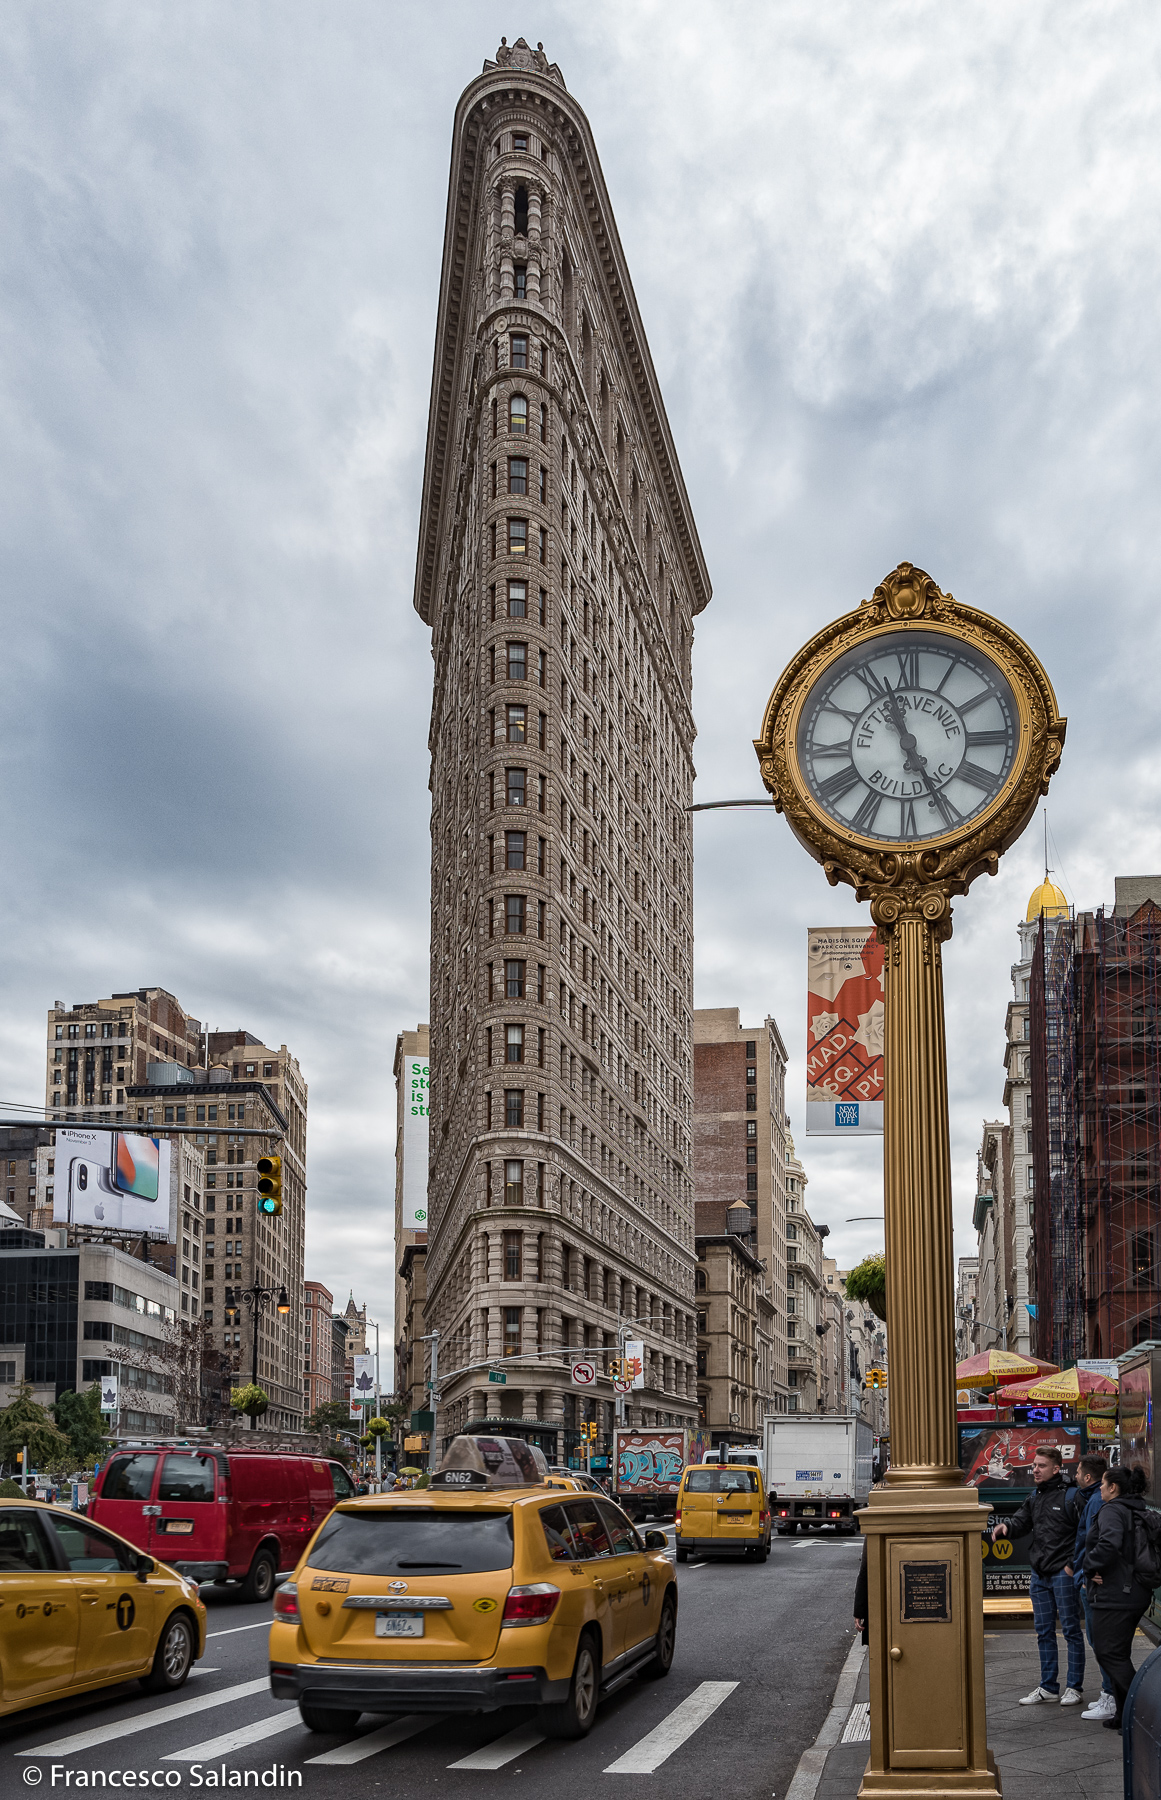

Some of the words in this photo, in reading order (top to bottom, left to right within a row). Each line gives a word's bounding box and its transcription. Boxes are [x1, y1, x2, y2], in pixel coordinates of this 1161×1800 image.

[902, 695, 961, 740] AVENUE
[411, 1090, 424, 1103] is
[839, 1105, 857, 1113] NEW
[837, 1111, 858, 1119] YORK
[67, 1130, 91, 1140] iPhone
[1031, 1391, 1055, 1399] HALAL
[445, 1472, 472, 1483] 6N62
[995, 1543, 1010, 1555] W
